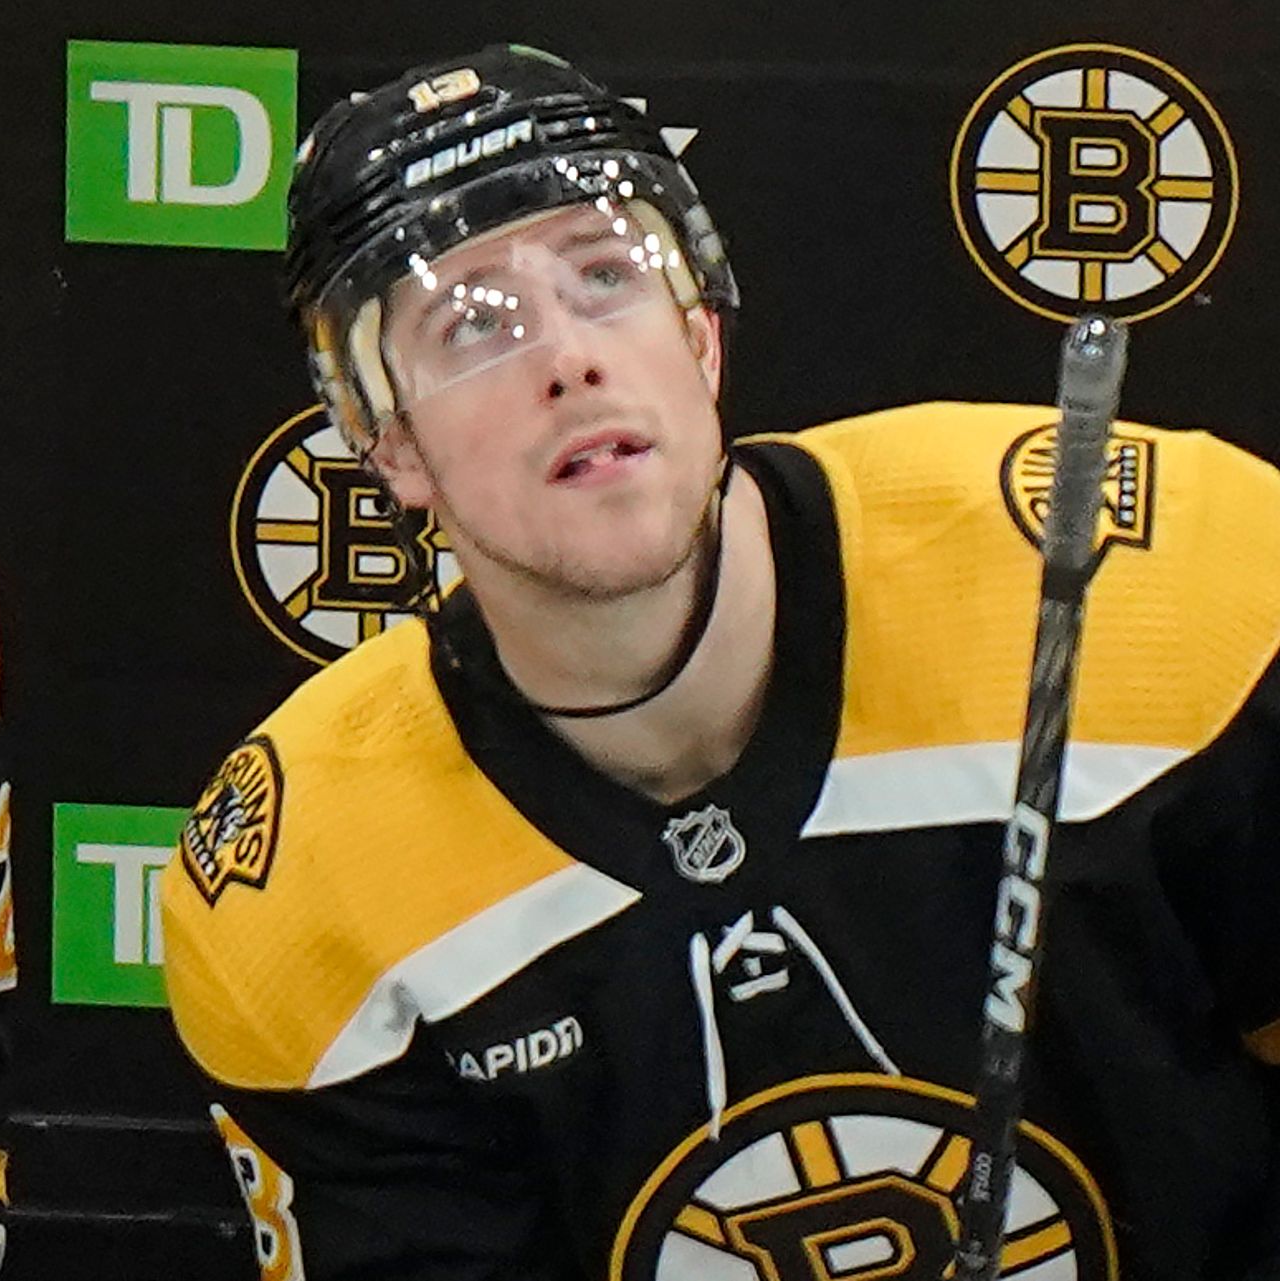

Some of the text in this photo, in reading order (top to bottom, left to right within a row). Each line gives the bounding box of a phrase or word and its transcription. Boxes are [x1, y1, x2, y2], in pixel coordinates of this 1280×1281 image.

[90, 81, 273, 207] TD
[1033, 108, 1158, 262] B
[309, 459, 436, 611] B
[983, 800, 1050, 1034] CCM
